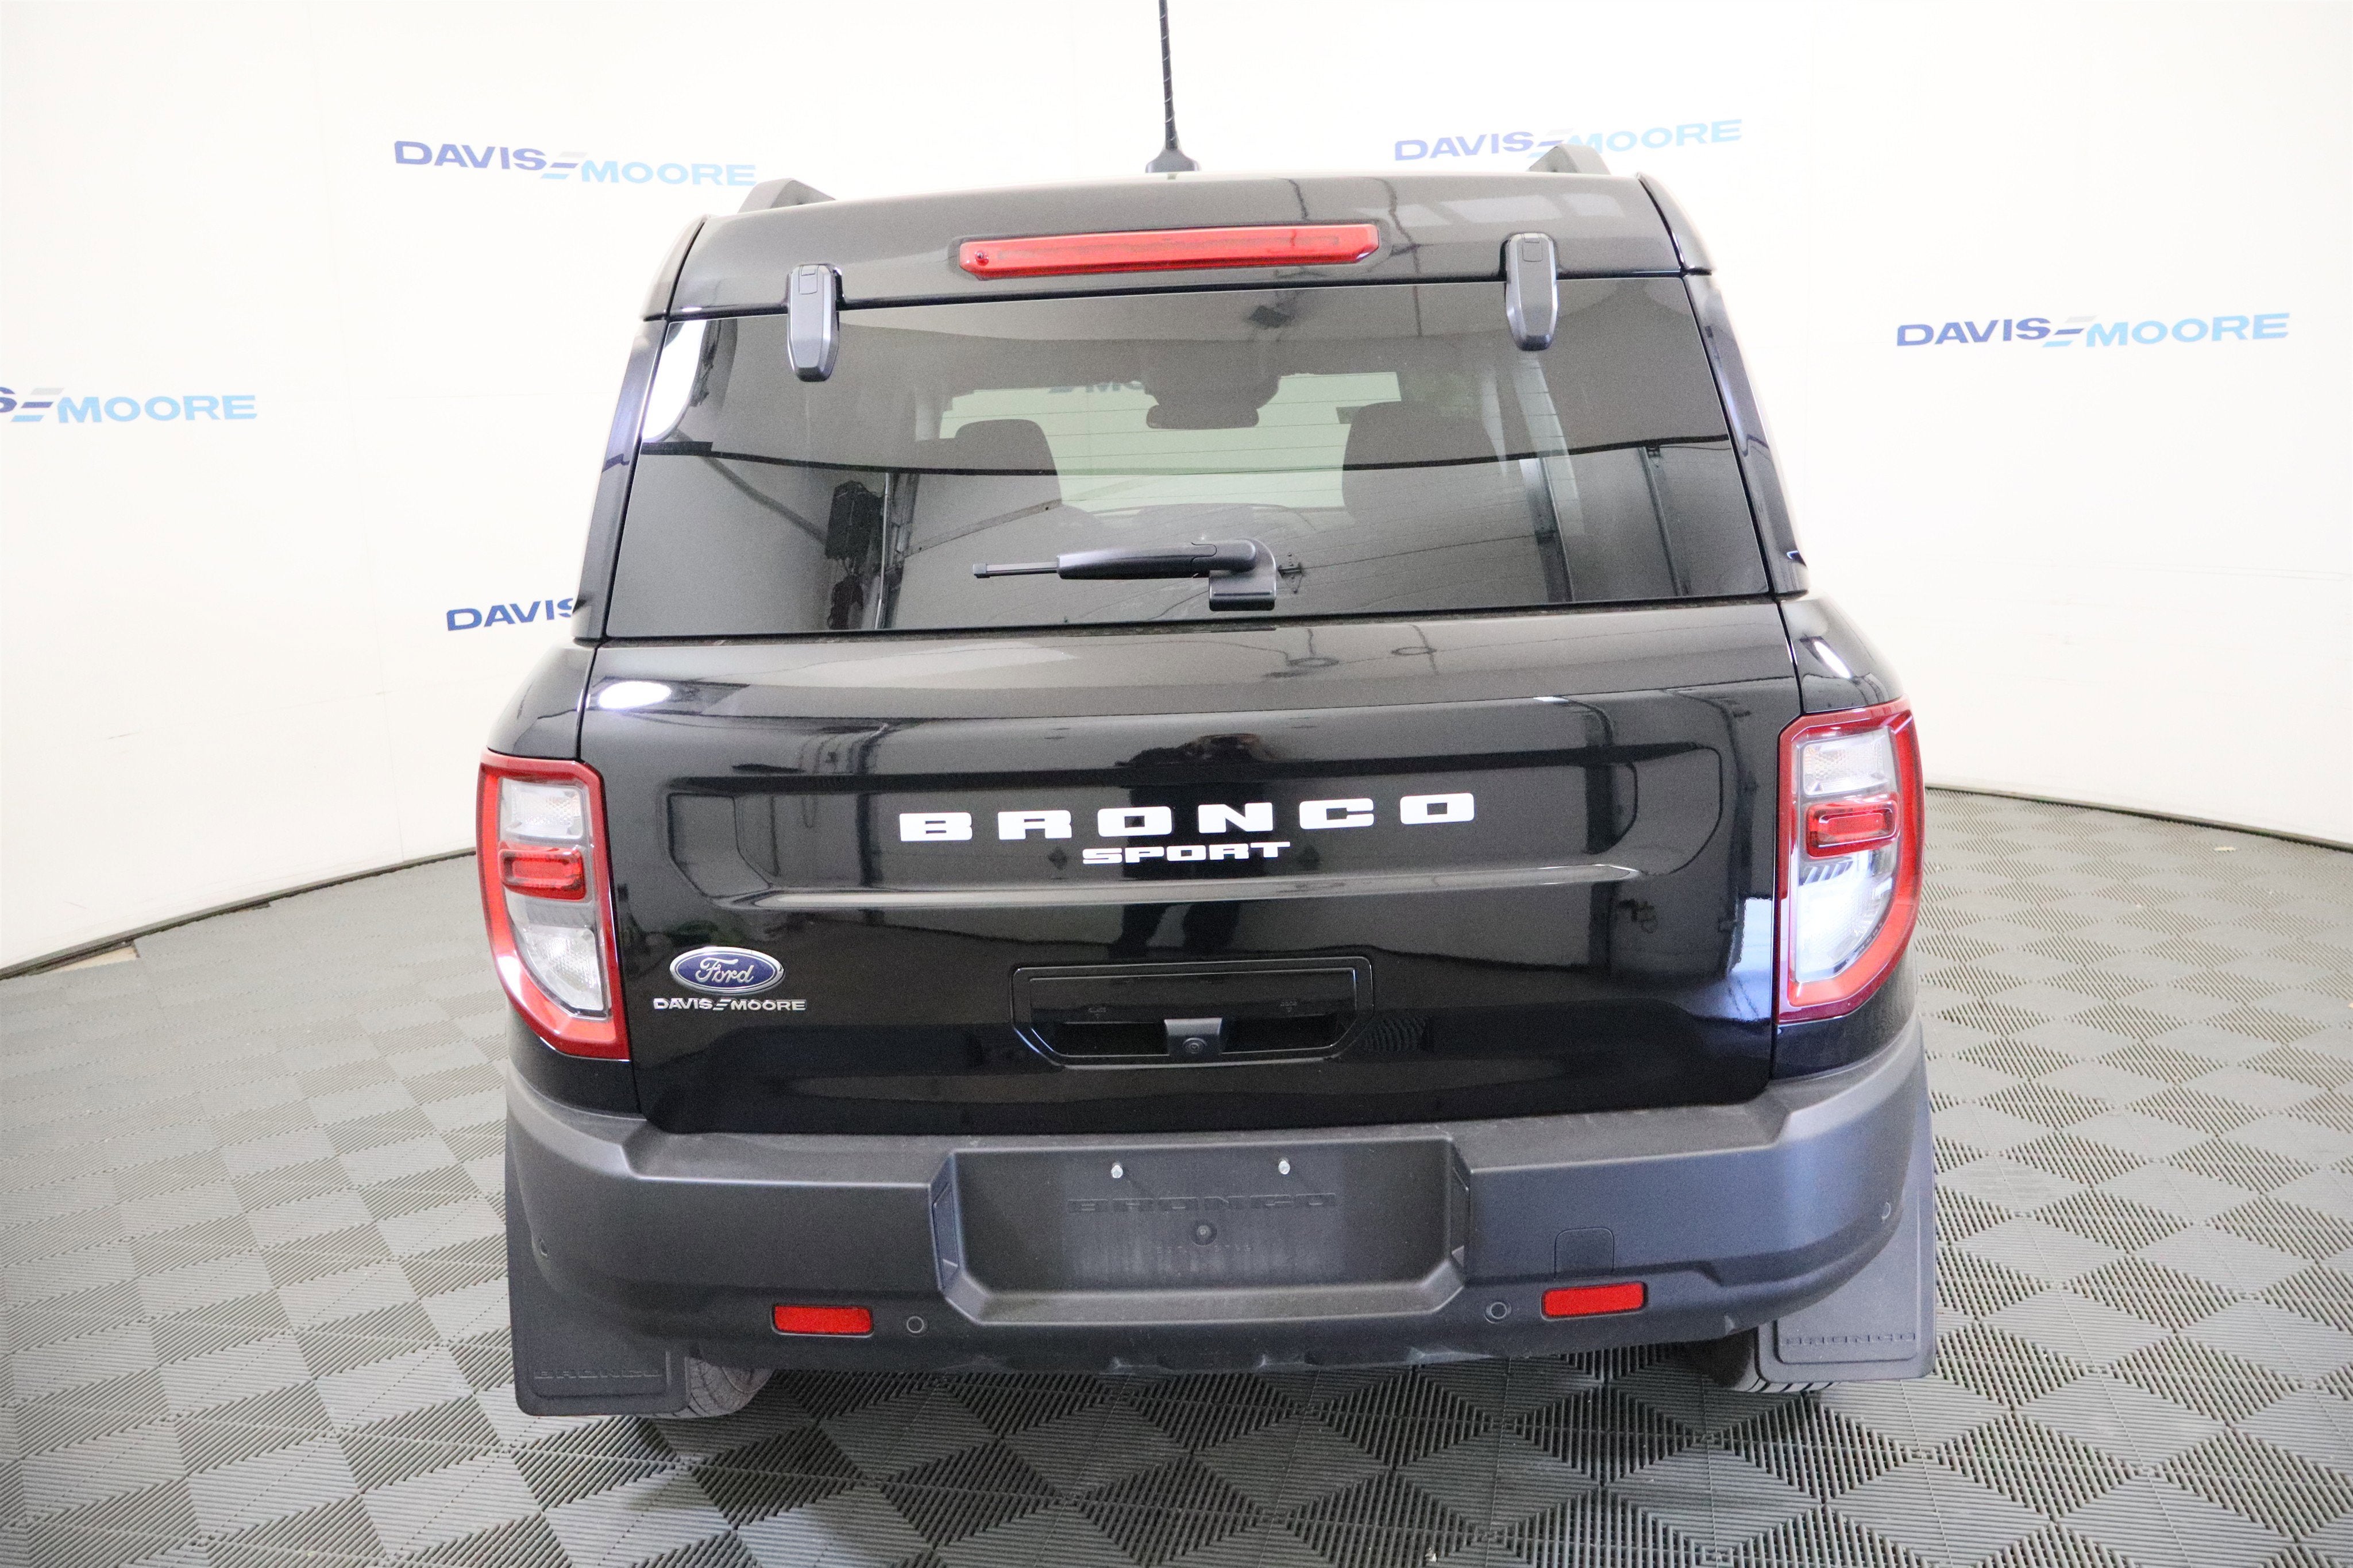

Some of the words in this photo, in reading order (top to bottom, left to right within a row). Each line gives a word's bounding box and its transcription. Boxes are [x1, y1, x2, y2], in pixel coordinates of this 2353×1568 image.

[1394, 132, 1534, 161] DAVIS
[394, 140, 547, 171] DAVIS
[581, 160, 757, 186] MOORE
[1896, 317, 2051, 347] DAVIS
[2086, 312, 2290, 348] MOORE
[57, 395, 258, 424] MOORE
[898, 792, 1476, 843] BRONCO
[1082, 841, 1291, 865] SPORT
[695, 956, 755, 984] Ford
[653, 998, 713, 1010] DAVIS
[730, 999, 807, 1011] MOORE
[1067, 1192, 1336, 1213] BRONCO
